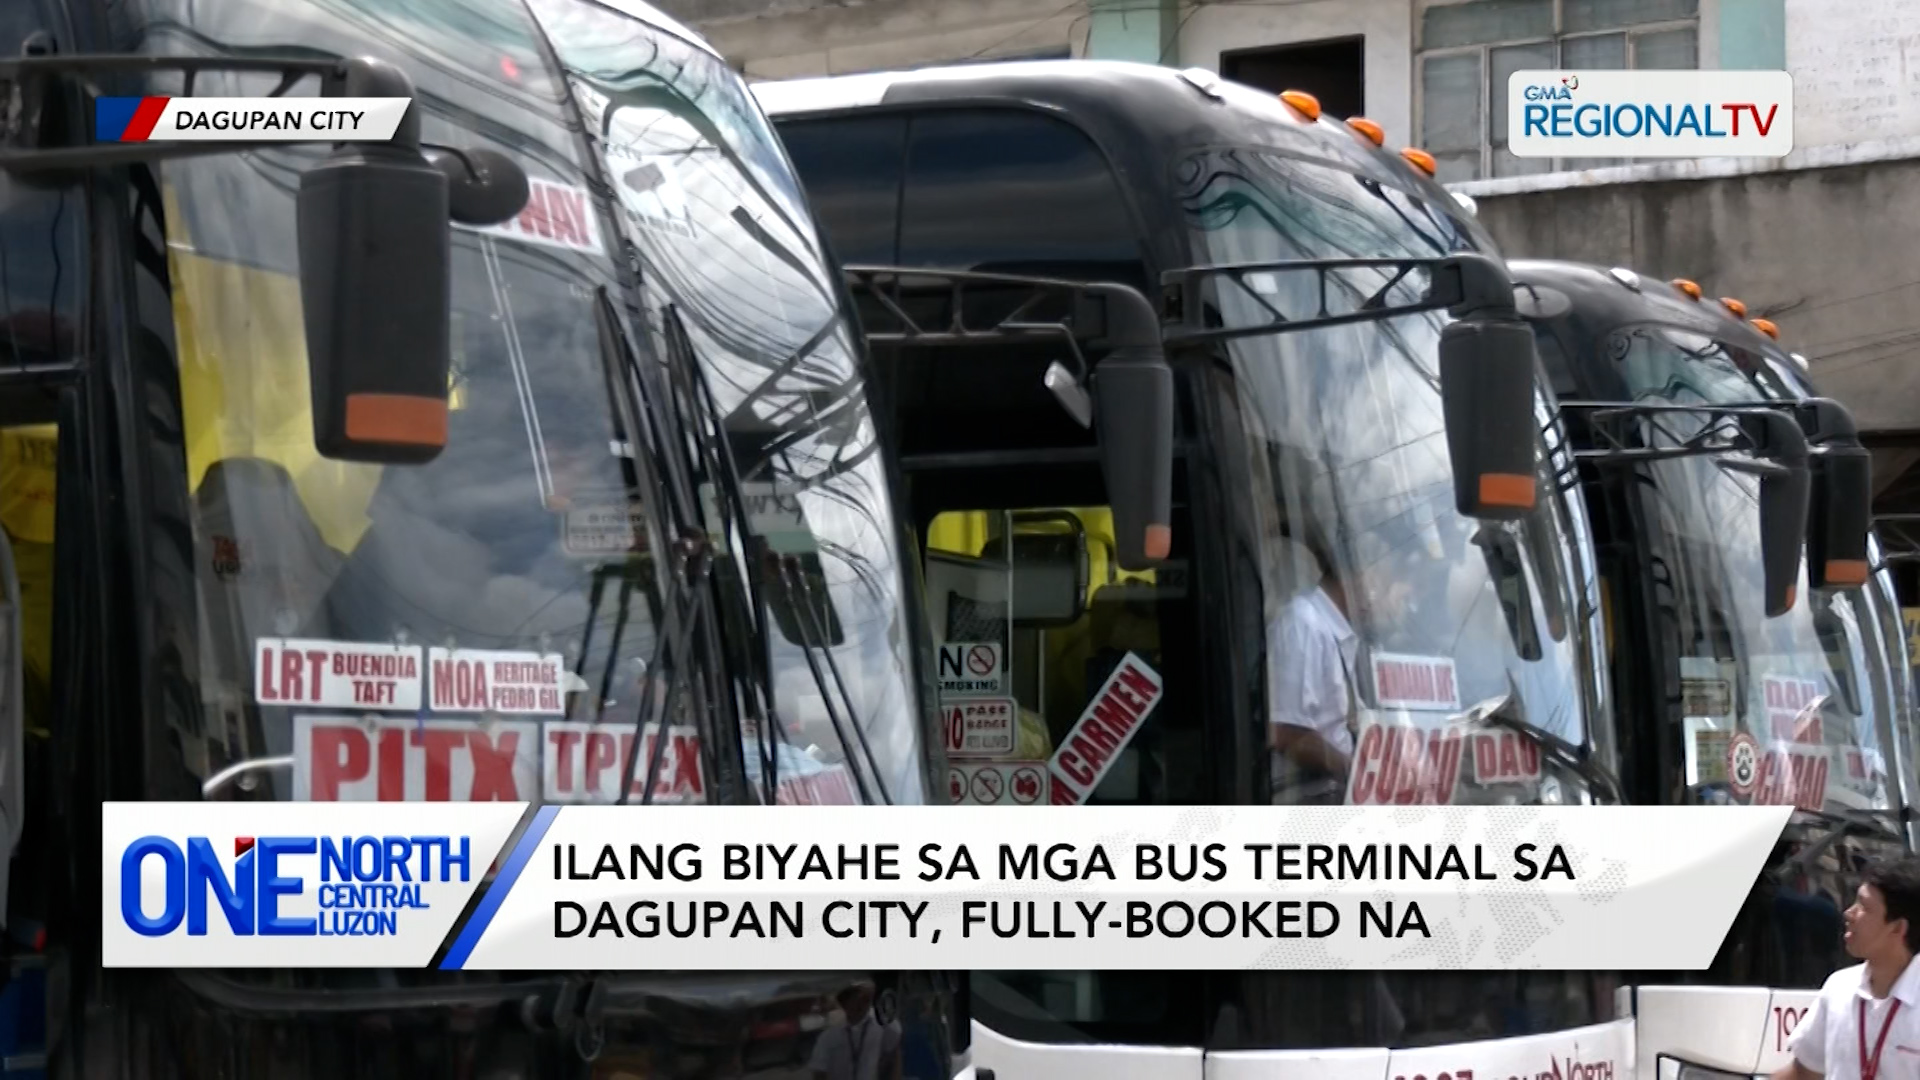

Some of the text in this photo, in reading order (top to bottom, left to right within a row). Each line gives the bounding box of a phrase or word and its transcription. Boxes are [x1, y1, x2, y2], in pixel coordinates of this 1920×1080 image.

[261, 647, 417, 700] LRT BUENDIA
[352, 680, 397, 704] TAFT
[433, 659, 557, 708] MOA HERITAGE
[492, 686, 559, 709] PEDRO GIL
[1058, 663, 1159, 787] CARMEN
[311, 725, 519, 801] PITX
[549, 731, 702, 796] TPLEX
[1353, 724, 1538, 805] CUBAO DAU
